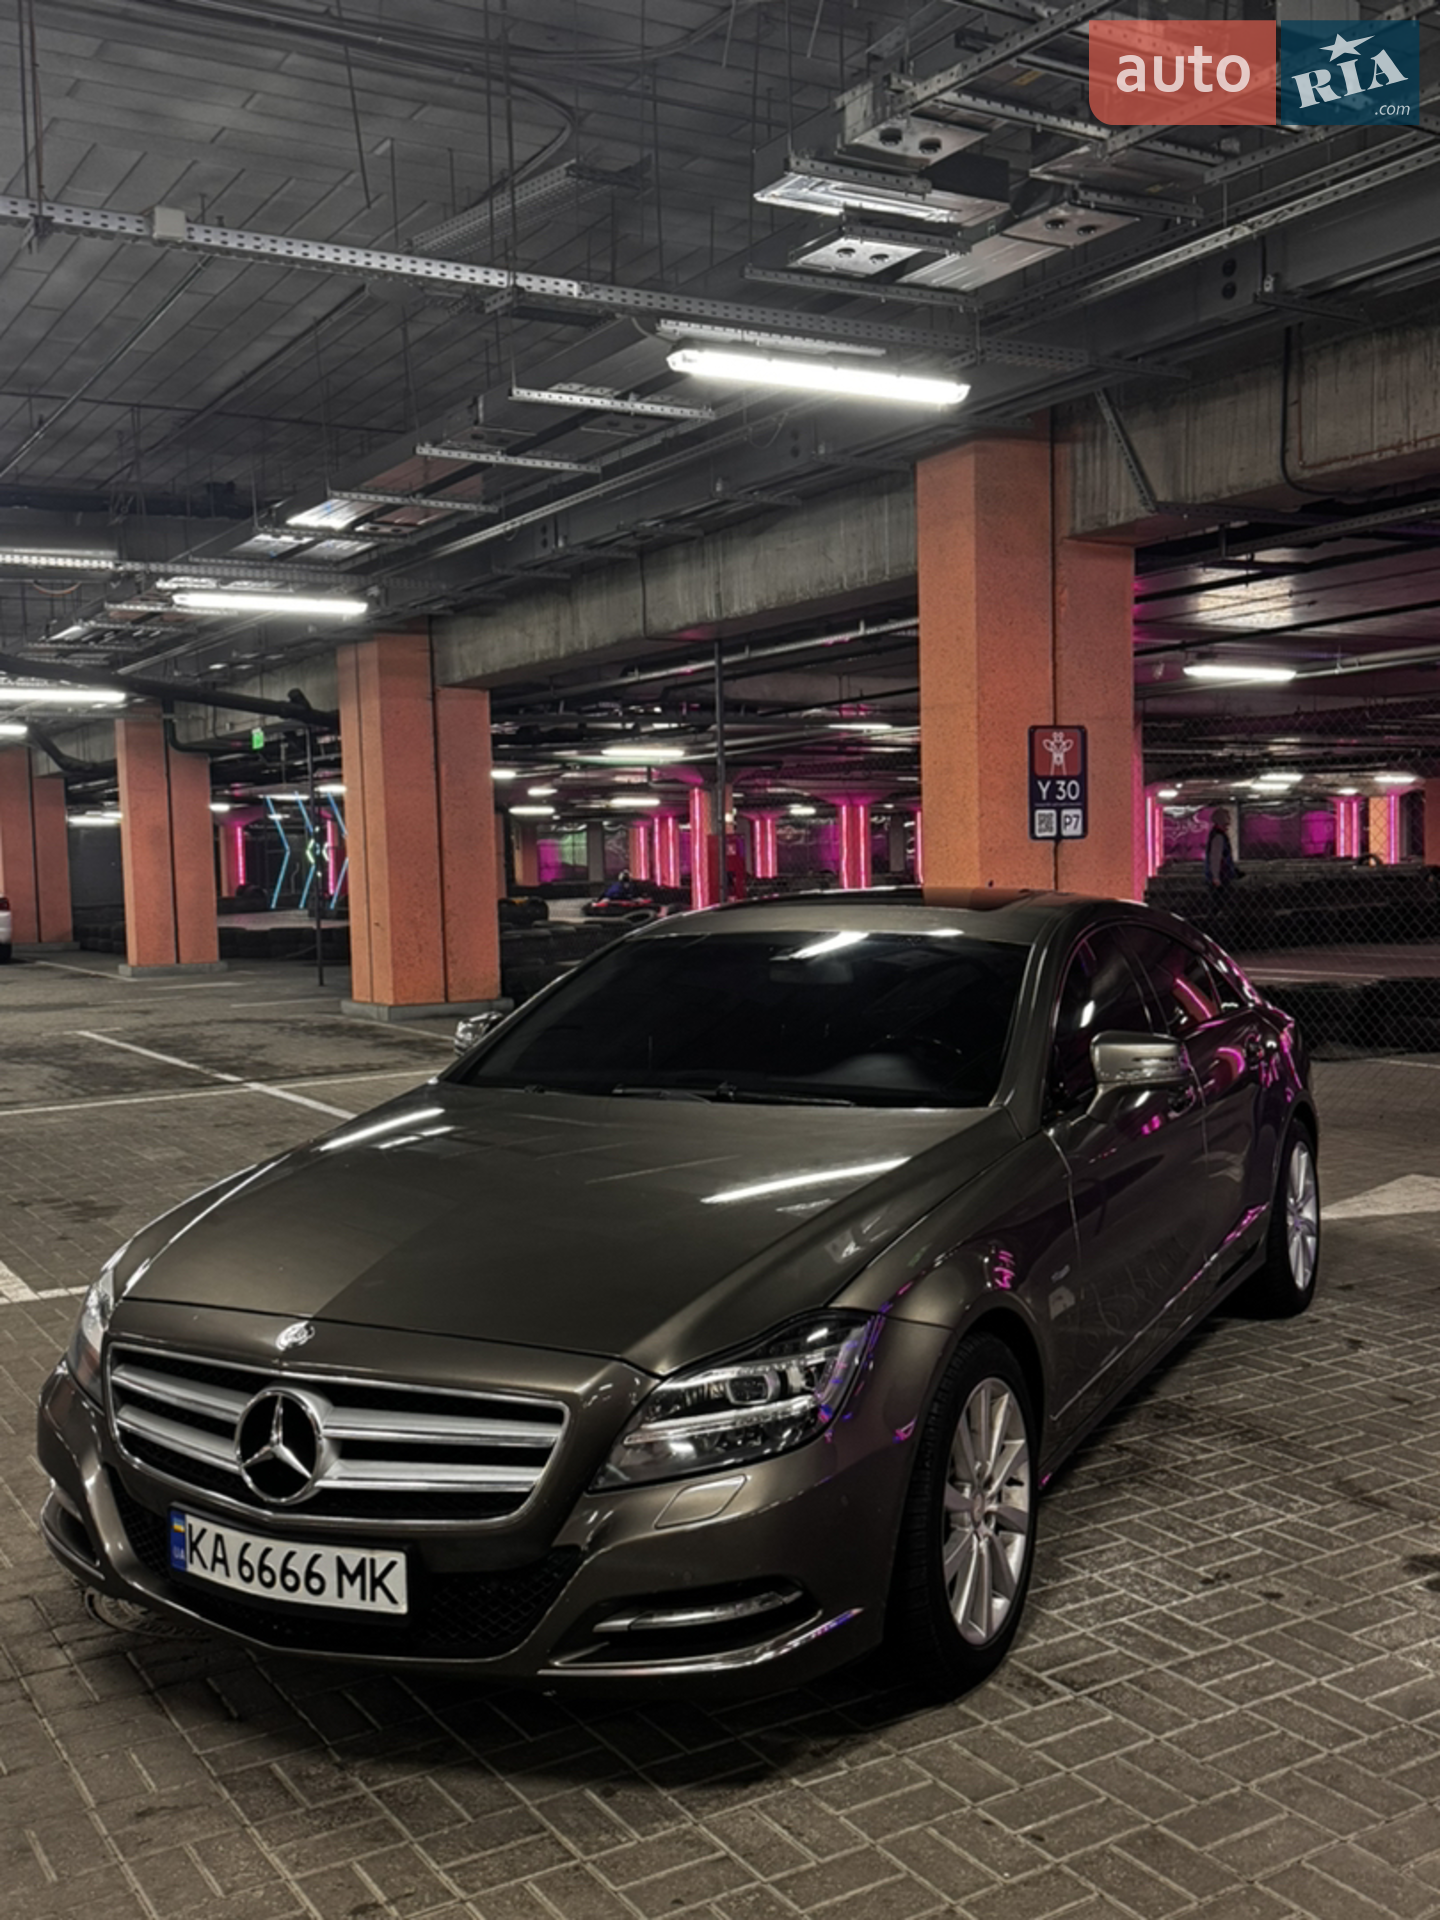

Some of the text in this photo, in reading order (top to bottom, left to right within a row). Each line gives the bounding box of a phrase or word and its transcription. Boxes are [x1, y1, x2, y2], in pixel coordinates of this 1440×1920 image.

[1037, 780, 1080, 801] Y 30
[1063, 814, 1080, 831] P7
[188, 1523, 399, 1605] KA 6666 MK
